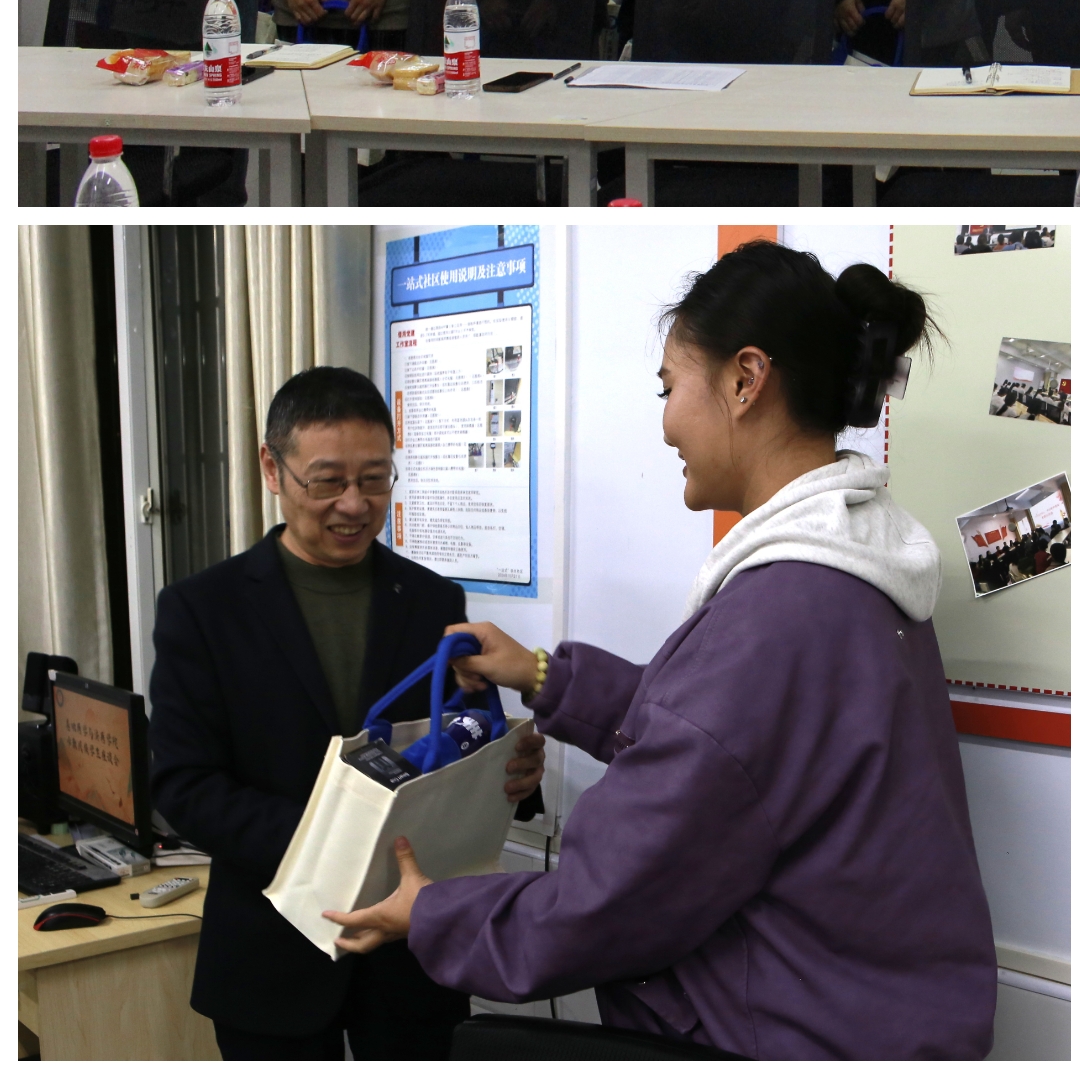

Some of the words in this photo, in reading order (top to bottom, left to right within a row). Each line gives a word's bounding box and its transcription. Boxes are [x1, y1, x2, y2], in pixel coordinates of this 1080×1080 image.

[398, 258, 527, 291] 一站式社区使用说明及注意事项
